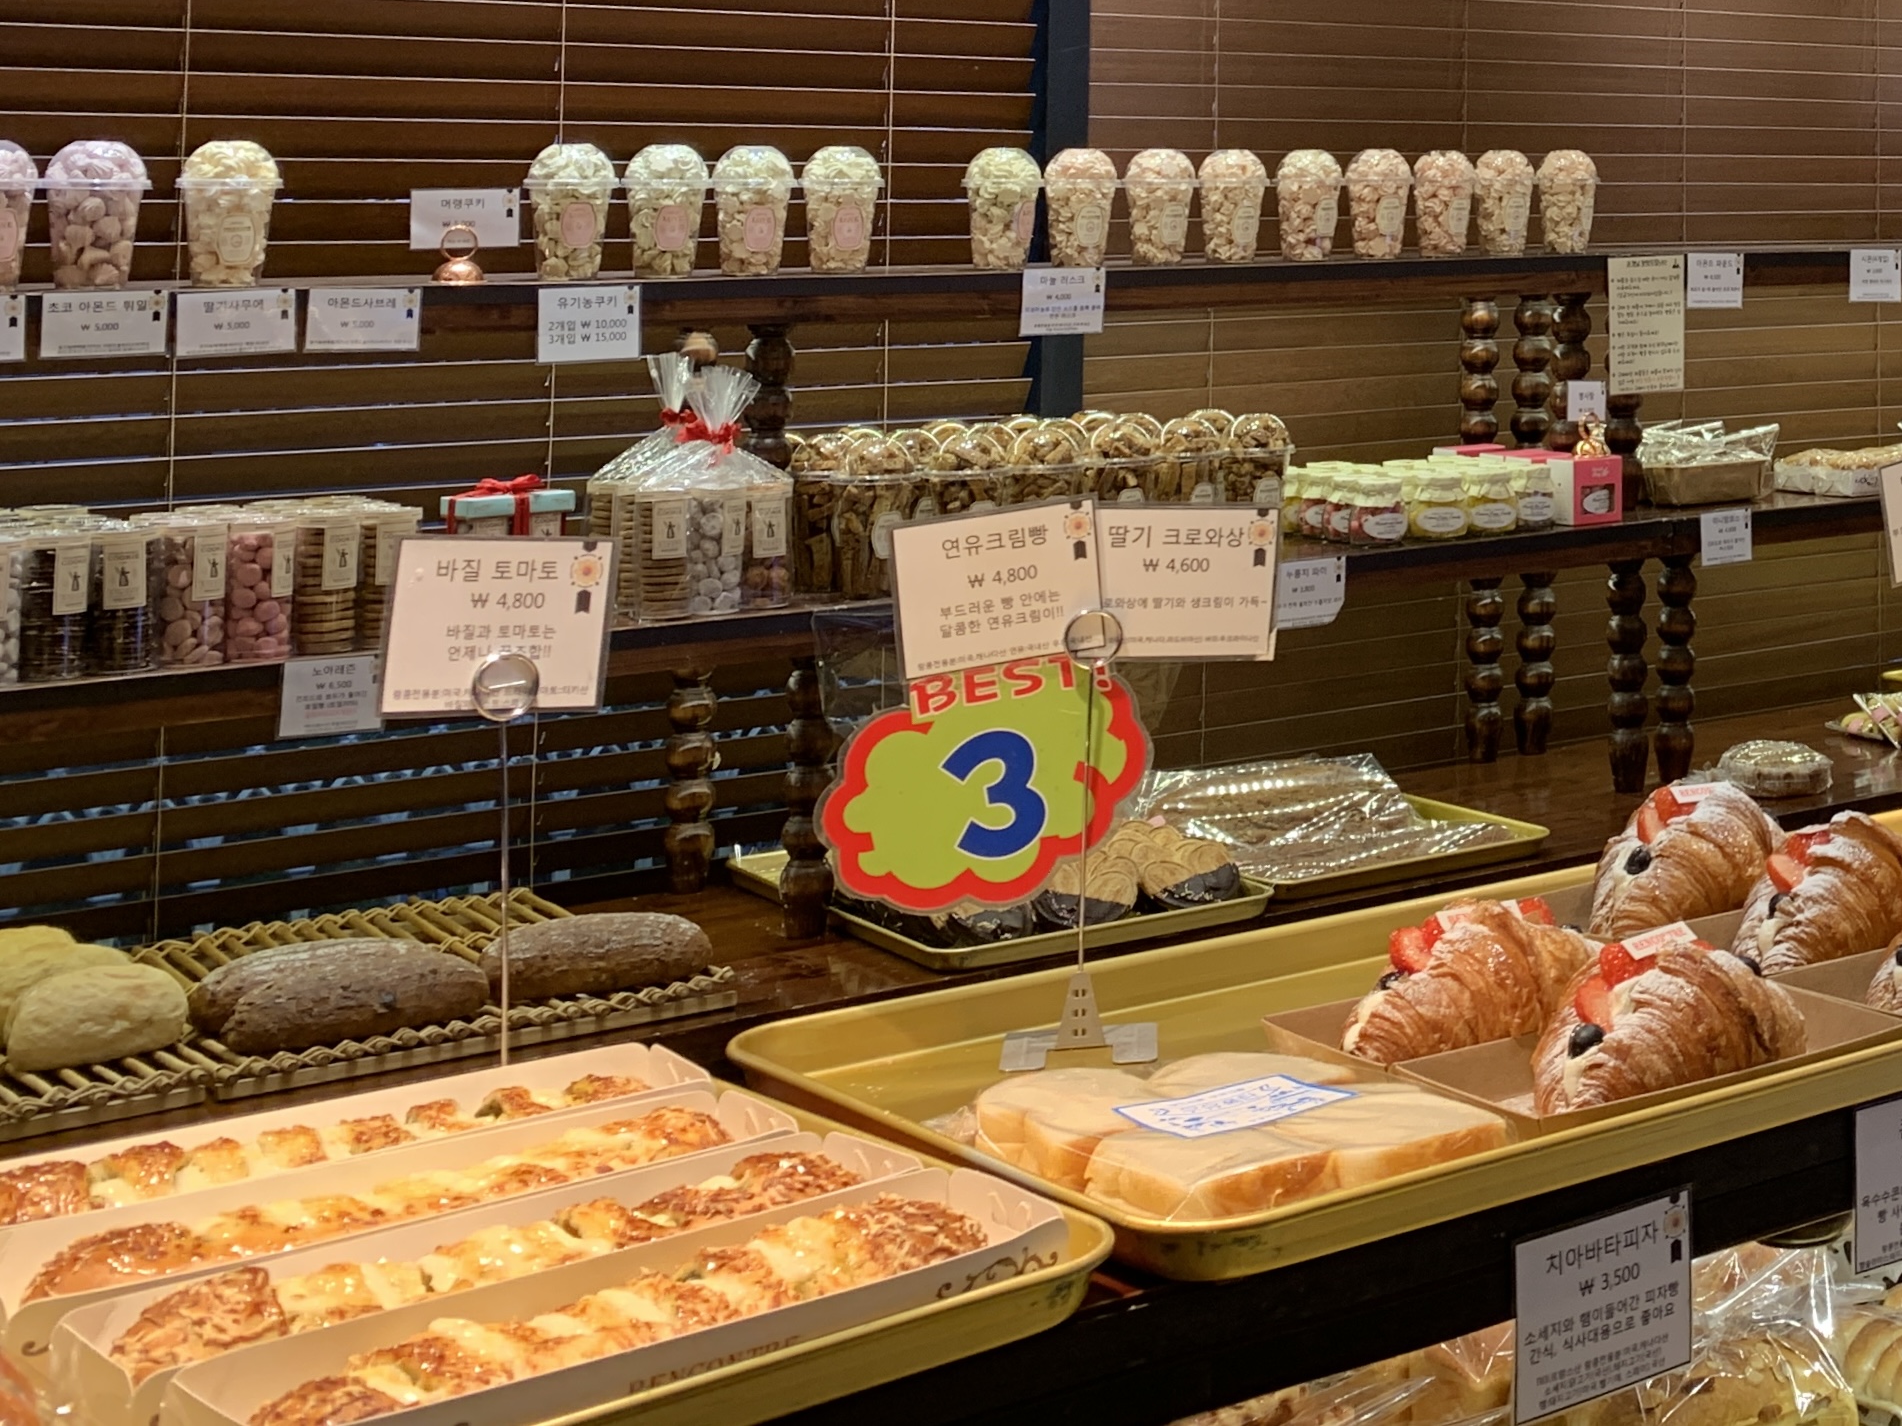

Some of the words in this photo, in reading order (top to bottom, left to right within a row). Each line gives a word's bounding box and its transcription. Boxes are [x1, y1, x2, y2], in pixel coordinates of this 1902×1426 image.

[48, 302, 73, 313] 초코
[79, 301, 117, 313] 아몬드
[327, 297, 396, 309] 아몬드사브레
[557, 295, 618, 309] 유기농쿠키
[81, 323, 91, 331] ₩
[94, 322, 119, 331] 5,000
[213, 322, 223, 330] ₩
[340, 320, 349, 328] ₩
[548, 319, 577, 332] 2개입
[580, 320, 591, 328] ₩
[595, 318, 627, 330] 10,000
[548, 332, 577, 344] 3개입
[580, 333, 591, 342] ₩
[595, 331, 627, 343] 15,000
[941, 524, 1049, 559] 연유크림빵
[1107, 524, 1151, 548] 딸기
[1162, 526, 1244, 548] 크로와상
[436, 559, 481, 581] 바질
[491, 559, 559, 581] 토마토
[1143, 557, 1160, 573] ₩
[1165, 556, 1210, 575] 4,600
[967, 572, 985, 588] ₩
[991, 564, 1038, 586] 4,800
[470, 592, 490, 608] ₩
[495, 591, 546, 611] 4,800
[939, 599, 995, 619] 부드러운
[1000, 596, 1014, 610] 빵
[1018, 589, 1061, 607] 안에는
[1152, 595, 1185, 609] 딸기와
[1190, 595, 1235, 609] 생크림이
[1238, 594, 1268, 609] 가득~
[445, 624, 491, 640] 바질과
[496, 624, 557, 640] 토마토는
[940, 617, 982, 639] 달콤한
[988, 605, 1064, 631] 연유크림이!!
[316, 682, 325, 690] ₩
[910, 655, 1113, 717] BEST!
[939, 728, 1047, 860] 3
[1545, 1219, 1659, 1276] 치아바타피자
[1579, 1281, 1595, 1297] ₩
[1601, 1262, 1641, 1291] 3,500
[1524, 1316, 1575, 1347] 소세지와
[1579, 1296, 1640, 1327] 햄이들어간
[1645, 1280, 1680, 1303] 피자빵
[1530, 1343, 1557, 1365] 간식,
[1562, 1315, 1636, 1351] 식사대용으로
[1640, 1302, 1676, 1326] 좋아요
